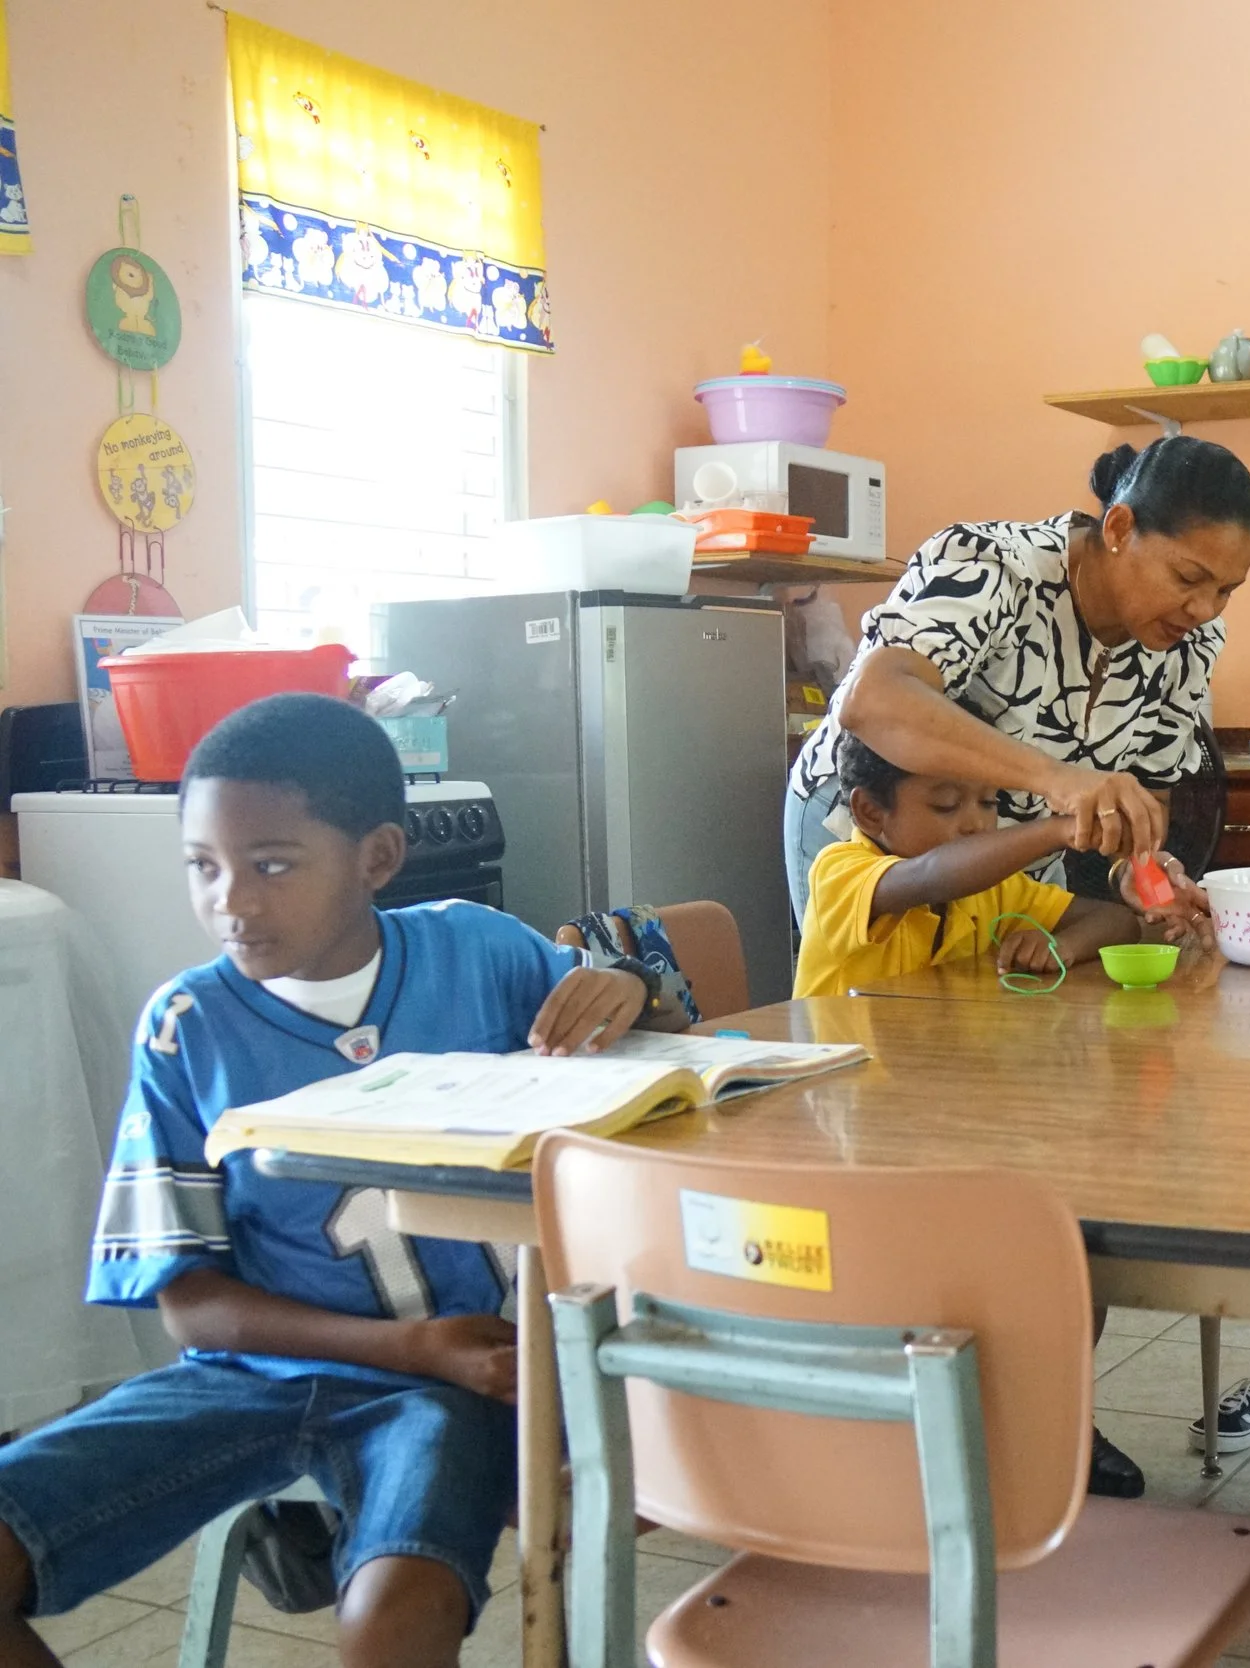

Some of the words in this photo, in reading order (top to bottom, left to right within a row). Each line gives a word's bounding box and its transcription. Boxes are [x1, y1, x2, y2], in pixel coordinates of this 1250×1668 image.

[103, 441, 119, 456] No
[120, 429, 172, 450] monkeying
[148, 441, 184, 462] around
